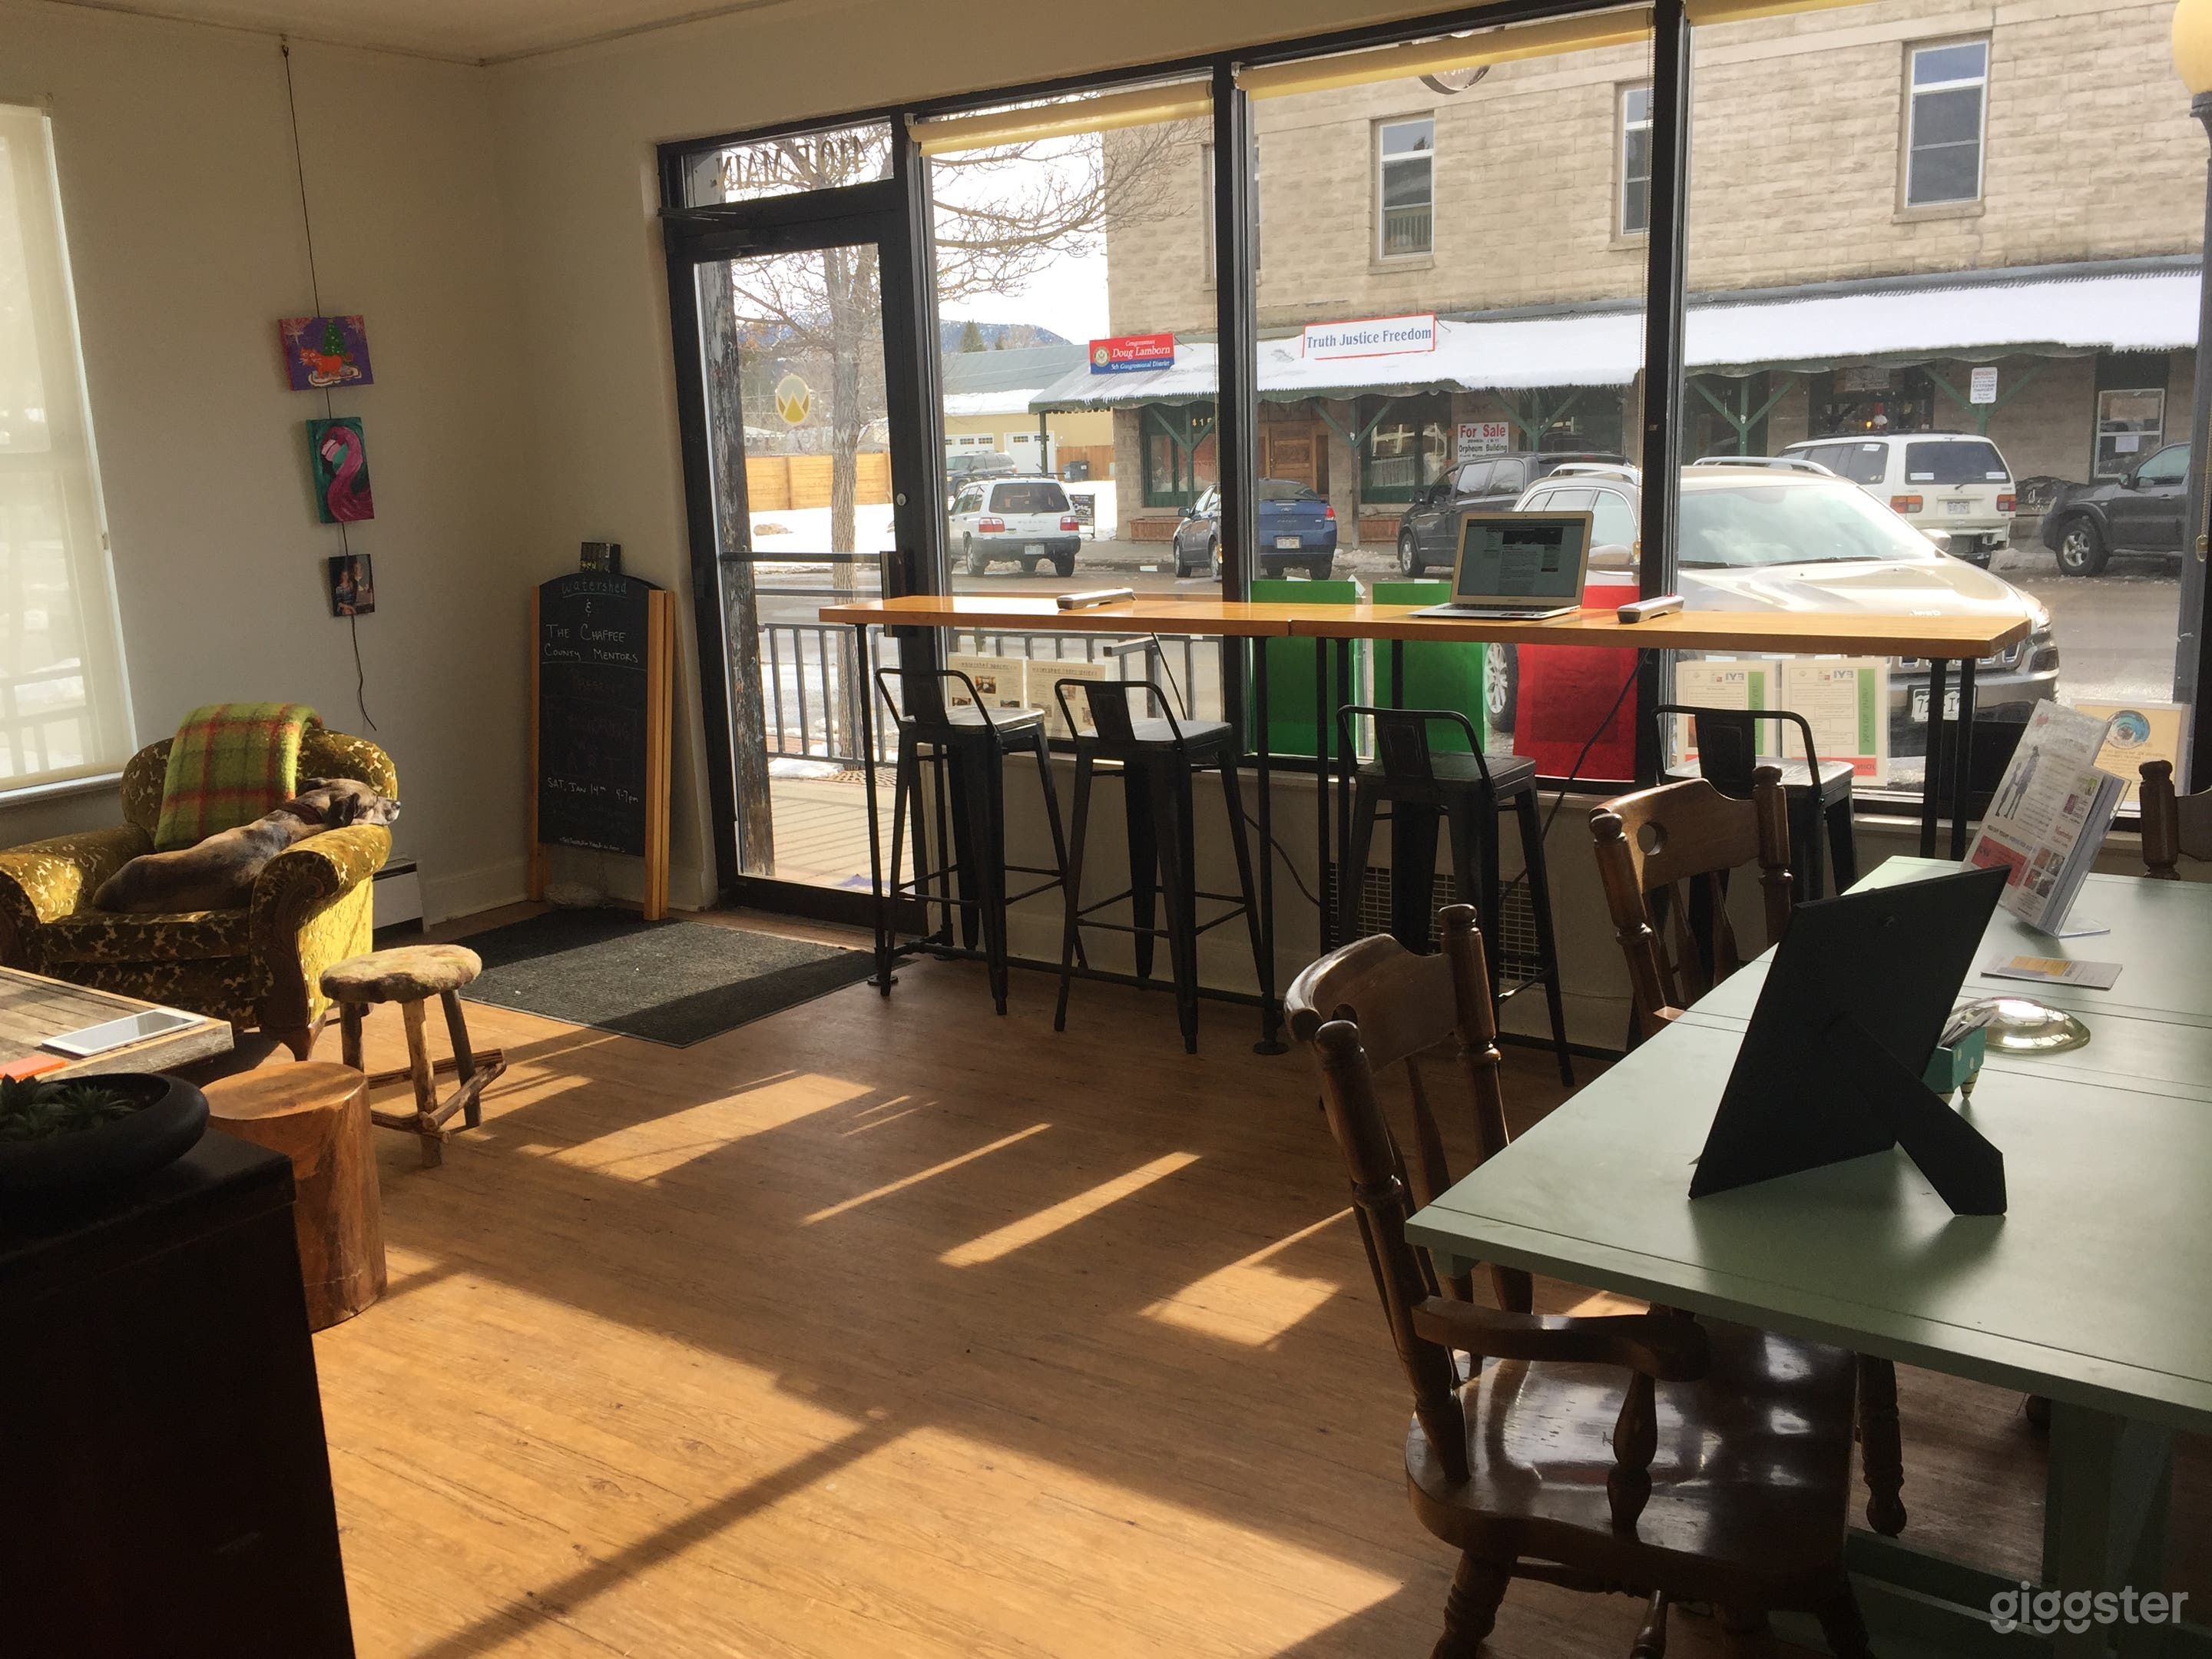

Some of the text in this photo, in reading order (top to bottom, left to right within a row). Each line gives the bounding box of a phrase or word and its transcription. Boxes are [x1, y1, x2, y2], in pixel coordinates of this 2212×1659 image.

[1307, 328, 1432, 348] Truth Justice Freedom
[1112, 346, 1171, 359] Doug Lamborn
[1460, 424, 1505, 438] For Sale
[545, 624, 626, 642] THE CHAFFEE
[593, 647, 638, 663] MENTORS
